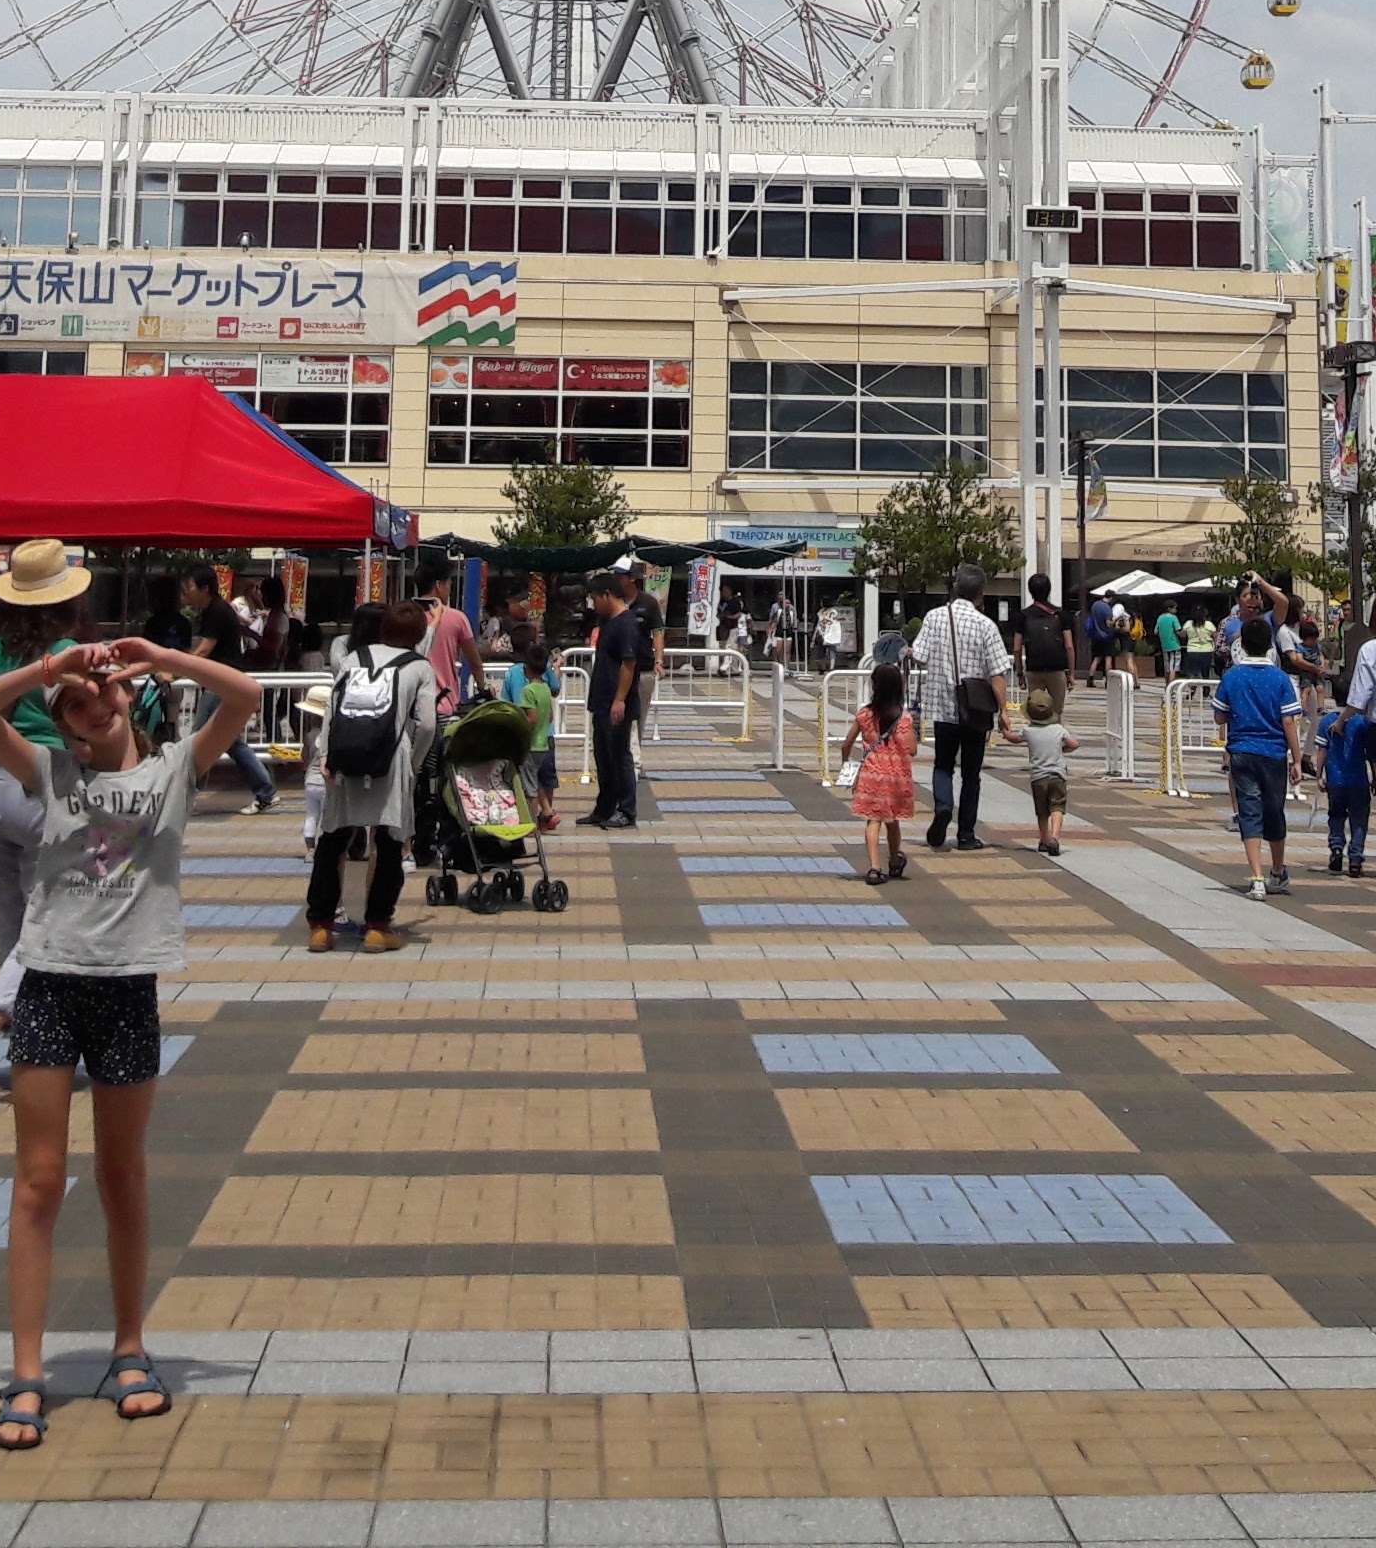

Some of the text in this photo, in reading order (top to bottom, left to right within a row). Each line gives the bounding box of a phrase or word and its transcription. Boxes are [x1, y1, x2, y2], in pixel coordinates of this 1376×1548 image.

[1034, 210, 1076, 227] 13:11
[729, 530, 858, 542] TEMPOZAN MARKETPLACE
